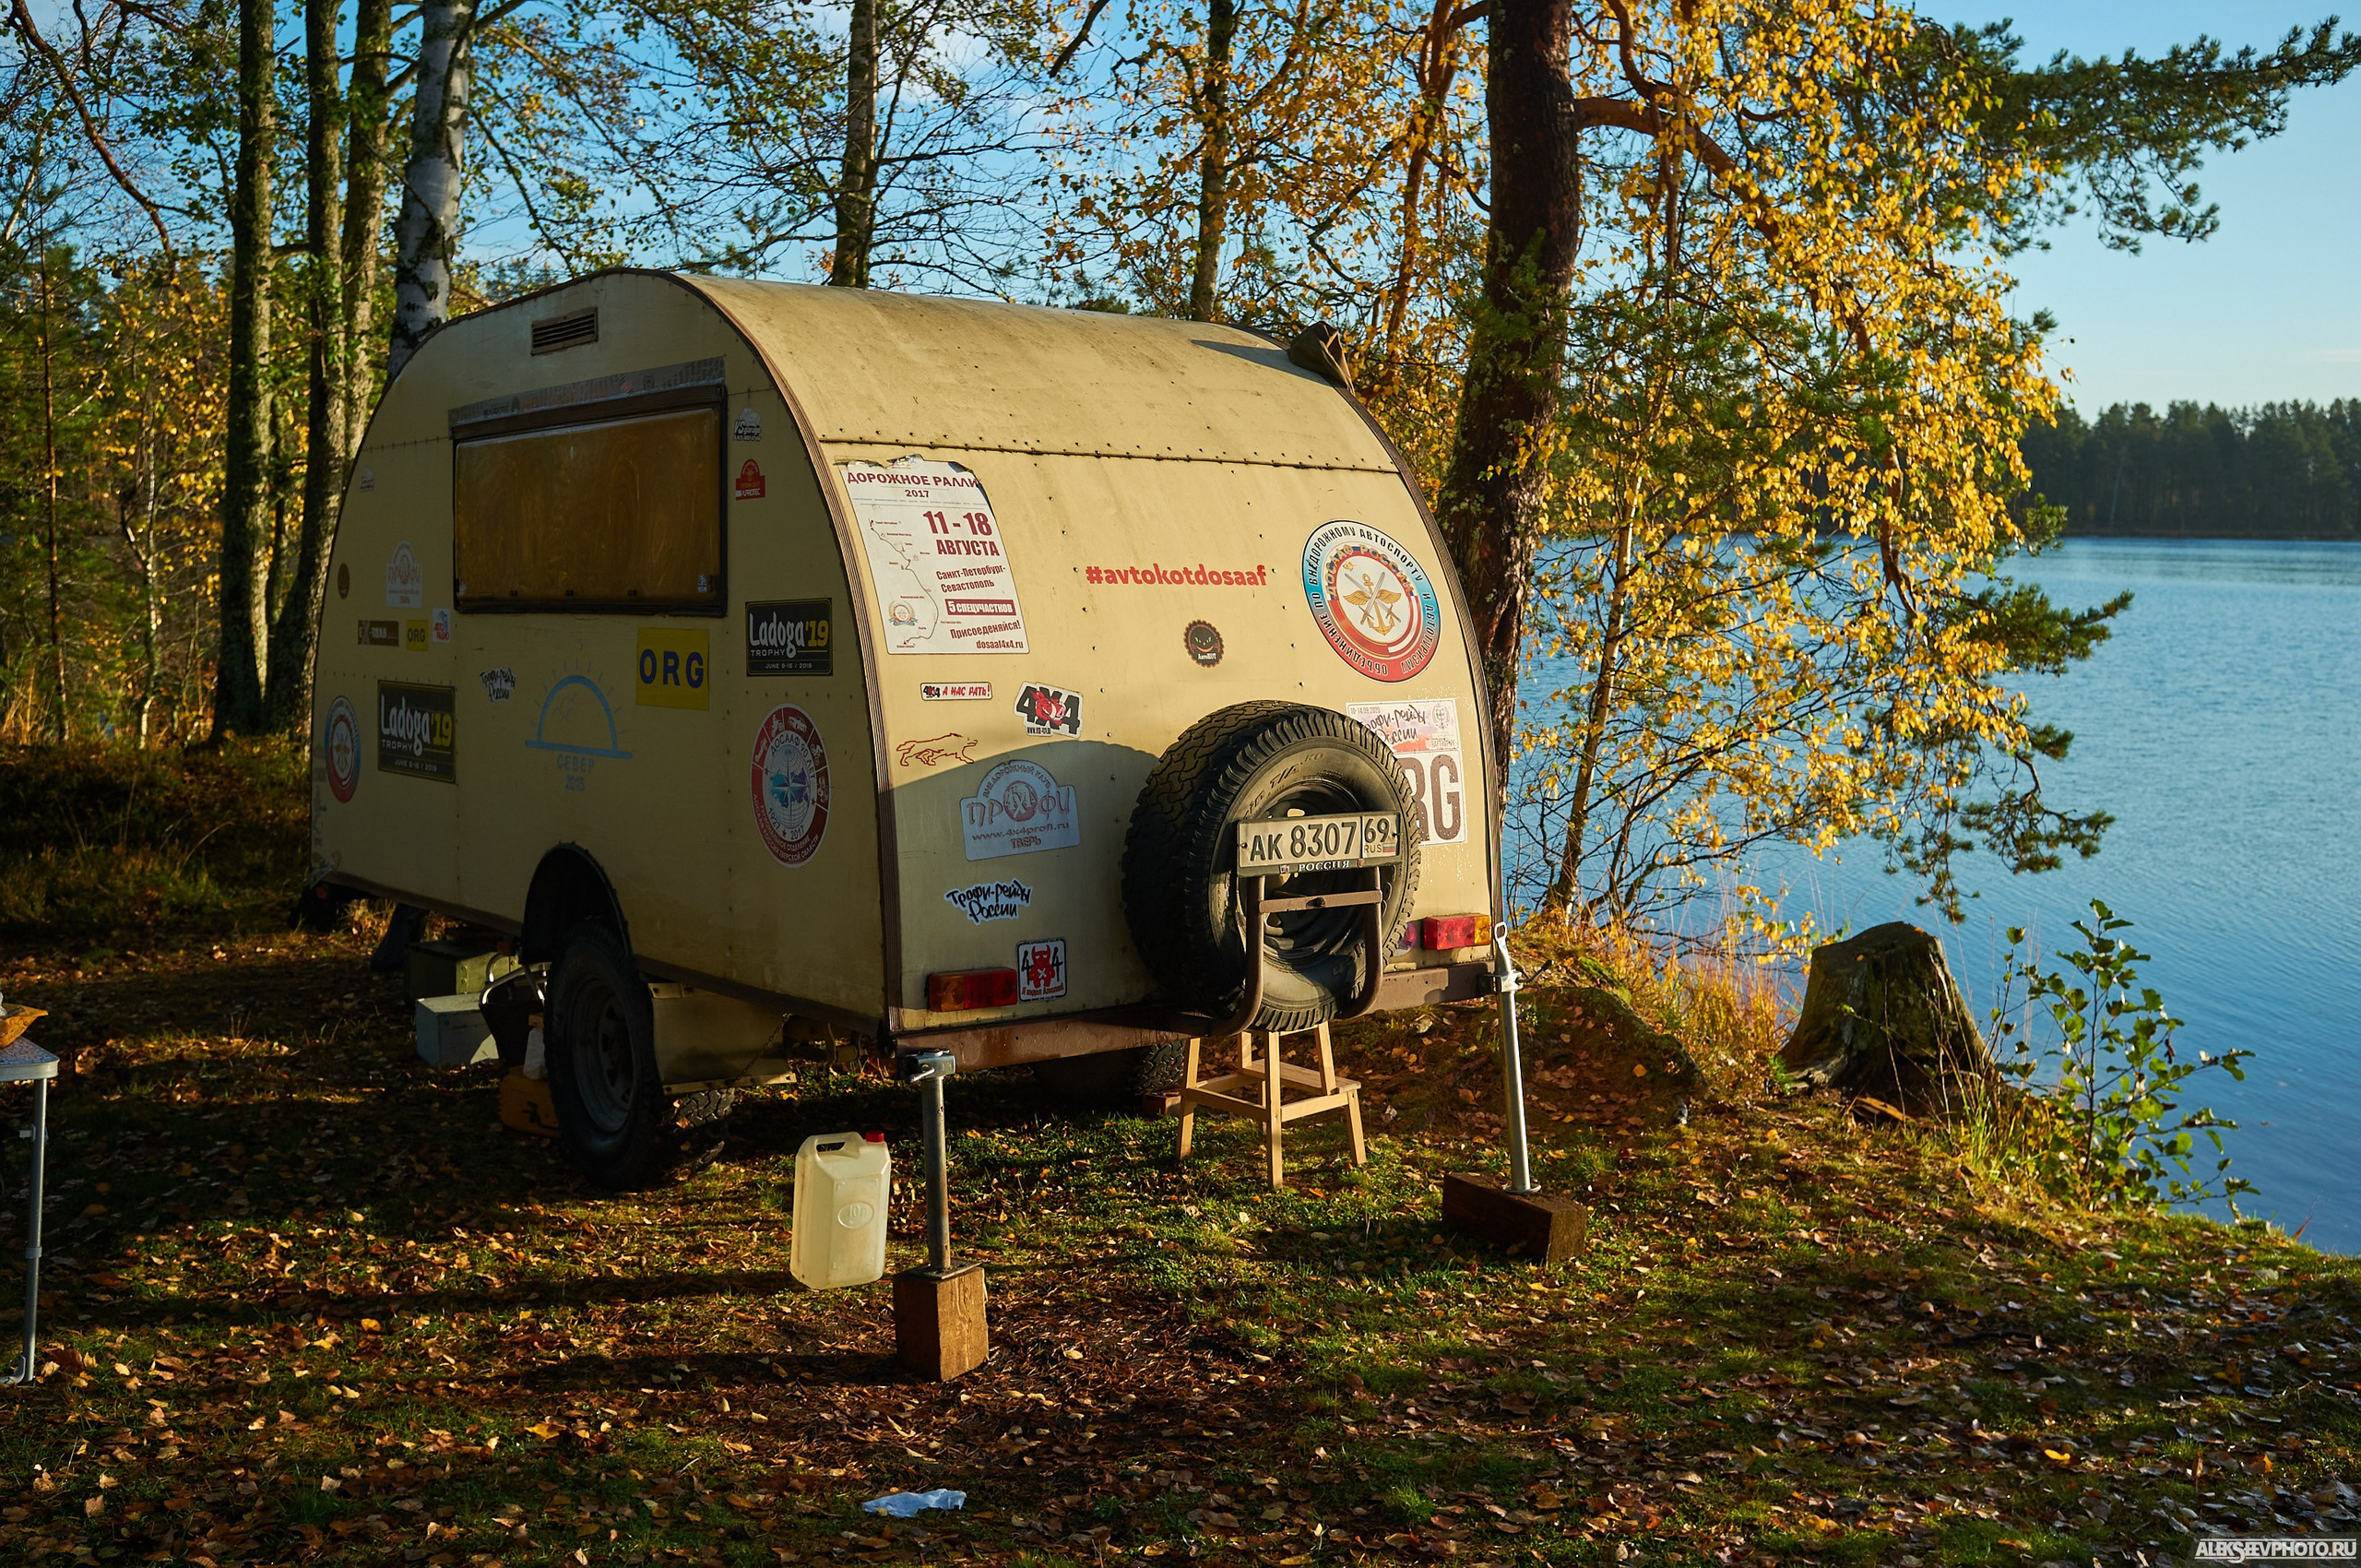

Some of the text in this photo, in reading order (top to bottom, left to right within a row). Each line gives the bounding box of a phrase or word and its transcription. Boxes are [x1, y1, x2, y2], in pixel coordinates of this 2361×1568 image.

[847, 471, 979, 488] ДОРОЖНОЕ РАЛЛИ
[904, 489, 930, 498] 2017
[922, 510, 950, 535] 11
[963, 511, 993, 537] 18
[936, 539, 1001, 557] АВГУСТА
[1307, 525, 1357, 587] ВНЕДОРОЖНОМУ
[1358, 528, 1425, 583] АВТОСПОРТУ
[1085, 563, 1267, 586] #avtokotdosaaf
[1324, 543, 1354, 598] ДОСААФ
[940, 578, 995, 593] Севастополь
[1310, 591, 1325, 610] ПО
[1421, 592, 1432, 600] И
[947, 600, 1014, 614] 5 СПЕЦУЧАСТКОВ
[407, 628, 425, 643] ORG
[1399, 604, 1437, 674] АВТОТУРИЗМУ
[750, 648, 786, 657] TROPHY
[639, 647, 705, 689] ORG
[942, 685, 948, 696] А
[950, 685, 967, 697] НАС
[381, 738, 414, 753] TROPHY
[770, 733, 801, 757] ДОСААФ
[806, 759, 816, 780] ЛЕТ
[790, 825, 805, 840] 2017
[1250, 817, 1390, 861] АК 8307 69
[1009, 835, 1042, 849] ТВЕРЬ
[1364, 843, 1382, 854] RUS
[1298, 859, 1351, 872] РОССИЯ
[967, 899, 1018, 923] России
